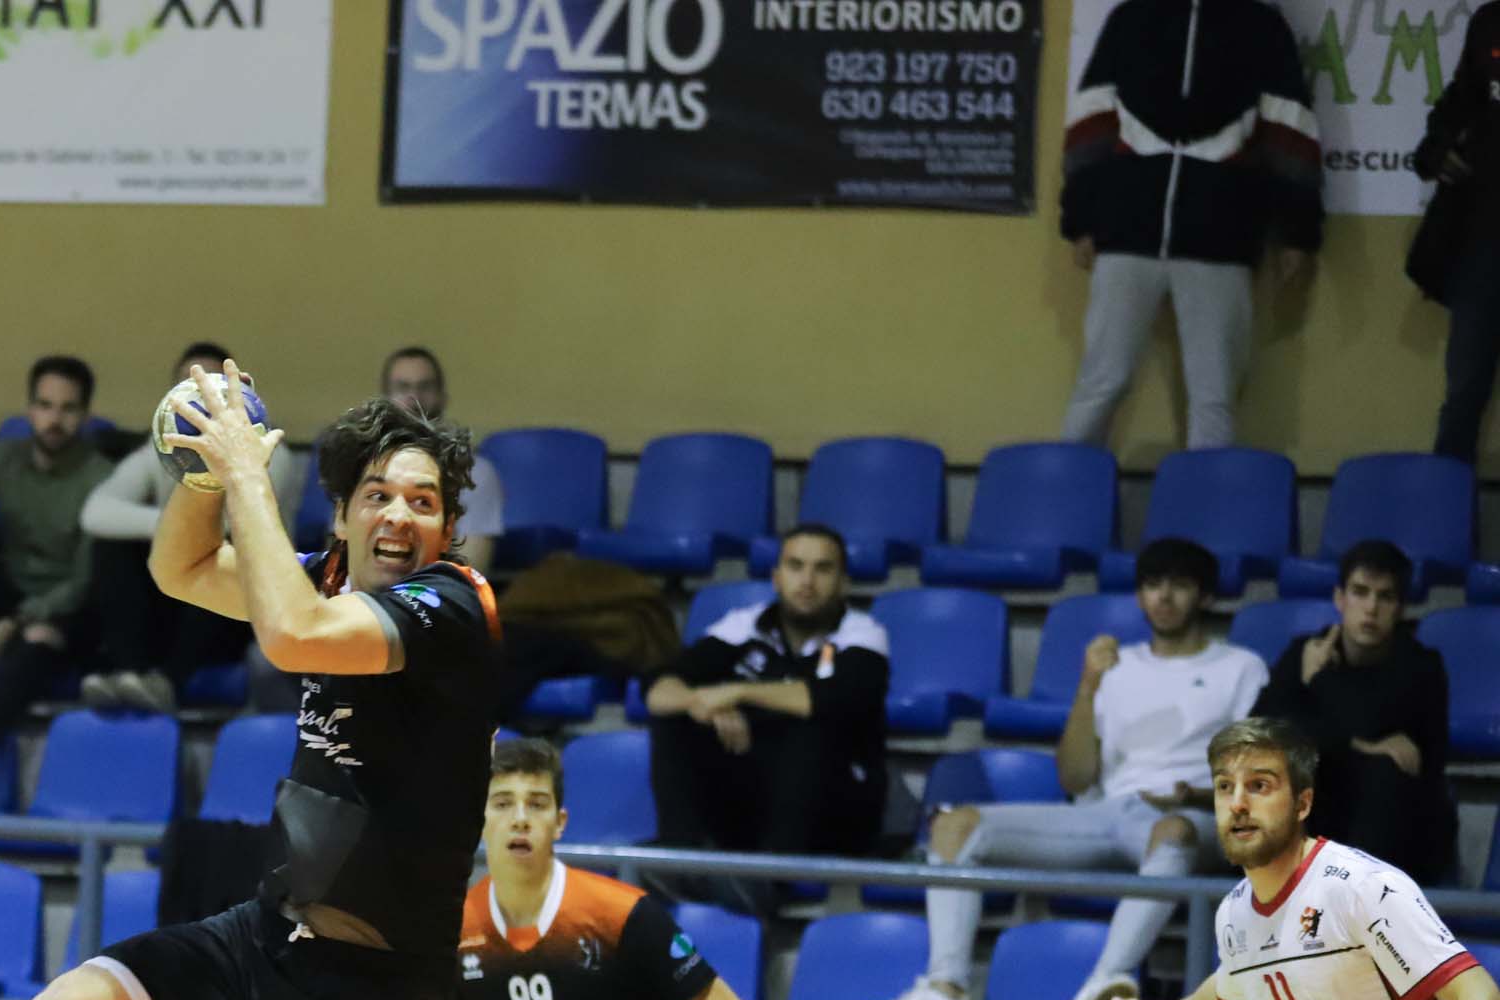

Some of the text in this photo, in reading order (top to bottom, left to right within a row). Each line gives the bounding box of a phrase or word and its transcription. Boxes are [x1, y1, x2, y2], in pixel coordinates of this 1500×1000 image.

[754, 0, 1025, 32] INTERIORISMO
[413, 0, 723, 73] SPAZIO
[825, 51, 1017, 84] 923 197 750
[527, 81, 708, 130] TERMAS
[821, 89, 1016, 120] 630 463 544
[1323, 865, 1350, 880] gala
